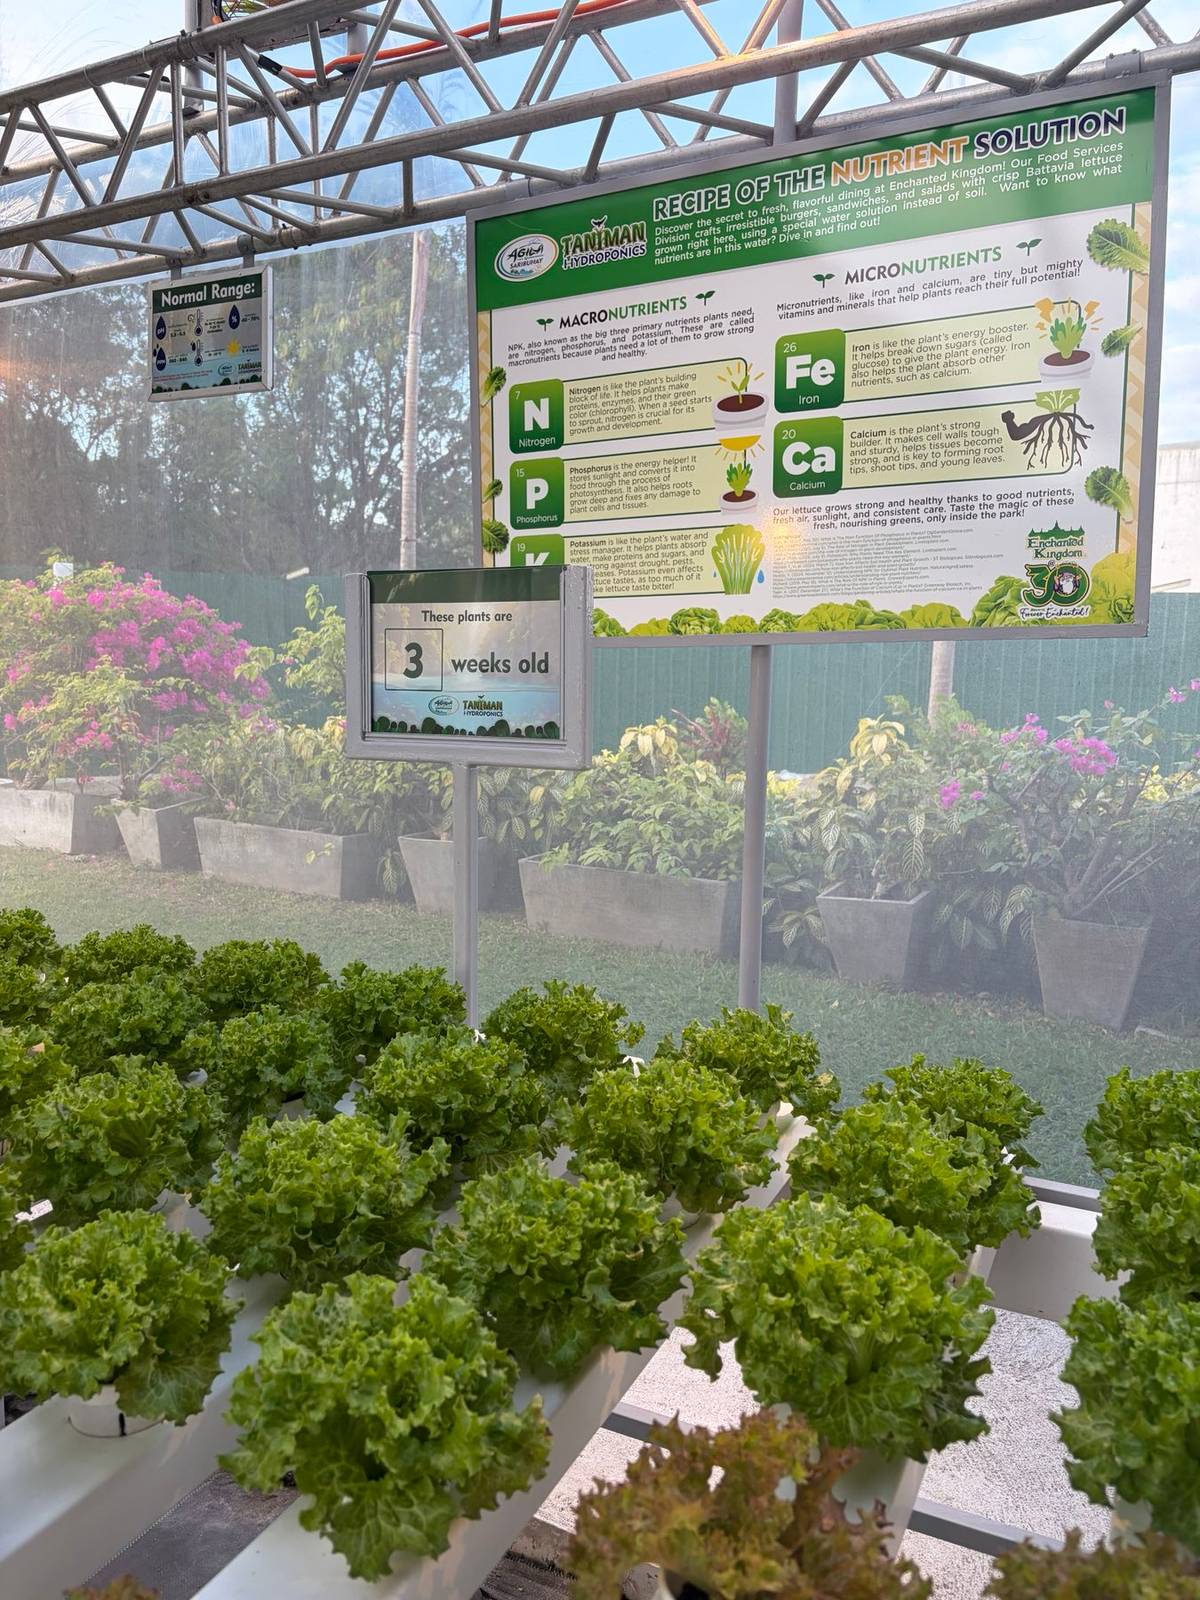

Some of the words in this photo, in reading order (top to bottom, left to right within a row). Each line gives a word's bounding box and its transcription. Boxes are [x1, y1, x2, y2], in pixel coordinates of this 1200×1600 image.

[653, 185, 729, 221] RECIPE
[736, 176, 770, 204] OF
[775, 164, 825, 196] THE
[832, 136, 969, 186] NUTRIENT
[974, 107, 1126, 159] SOLUTION
[655, 222, 692, 236] Discover
[697, 218, 711, 228] the
[715, 212, 743, 224] secret
[748, 210, 757, 219] to
[762, 203, 788, 216] fresh,
[792, 194, 833, 211] flavorful
[838, 190, 870, 202] dining
[874, 186, 884, 196] at
[889, 173, 949, 193] Enchanted
[951, 163, 1005, 182] Kingdom!
[1010, 160, 1030, 171] Our
[1037, 151, 1067, 166] Food
[1073, 144, 1122, 160] Services
[655, 233, 689, 245] Division
[695, 226, 720, 238] crafts
[726, 216, 774, 232] irresistible
[780, 209, 820, 223] burgers,
[826, 197, 888, 214] sandwiches,
[895, 190, 914, 202] and
[921, 184, 954, 198] salads
[961, 177, 985, 190] with
[991, 173, 1019, 185] crisp
[1026, 162, 1074, 179] Battavia
[1081, 154, 1122, 169] lettuce
[654, 244, 682, 257] grown
[687, 237, 708, 250] right
[713, 234, 736, 244] here,
[741, 229, 766, 240] using
[782, 218, 816, 234] special
[822, 214, 849, 225] water
[856, 206, 897, 219] solution
[903, 195, 942, 211] instead
[947, 192, 959, 203] of
[964, 188, 987, 200] soil.
[1000, 180, 1029, 194] Want
[1036, 178, 1048, 188] to
[1054, 172, 1085, 185] know
[1092, 164, 1121, 178] what
[654, 251, 693, 264] nutrients
[696, 248, 710, 257] are
[713, 246, 721, 254] in
[724, 242, 741, 252] this
[744, 235, 775, 249] water?
[779, 233, 800, 243] Dive
[803, 230, 812, 239] in
[814, 225, 833, 237] and
[837, 221, 856, 233] find
[859, 217, 880, 229] out!
[563, 244, 646, 270] HYDROPONICS
[844, 246, 1001, 285] MICRONUTRIENTS
[161, 286, 207, 307] Normal
[212, 282, 255, 299] Range:
[776, 296, 841, 311] Micronutrients,
[849, 292, 864, 301] like
[871, 289, 889, 298] iron
[897, 283, 914, 294] and
[922, 279, 961, 290] calcium,
[969, 275, 985, 284] are
[993, 271, 1012, 281] tiny
[1020, 266, 1037, 276] but
[1046, 260, 1082, 273] mighty
[778, 308, 814, 319] vitamins
[817, 303, 833, 313] and
[836, 298, 874, 310] minerals
[877, 294, 895, 305] that
[898, 292, 919, 302] help
[922, 287, 951, 300] plants
[954, 281, 981, 294] reach
[985, 279, 1008, 289] their
[1011, 275, 1027, 286] full
[1030, 267, 1079, 285] potential!
[560, 297, 687, 329] MACRONUTRIENTS
[784, 343, 796, 353] 26
[852, 343, 870, 352] Iron
[872, 341, 879, 350] is
[882, 339, 897, 348] like
[900, 337, 915, 346] the
[918, 332, 948, 346] plant's
[951, 329, 985, 340] energy
[988, 324, 1028, 336] booster.
[785, 354, 835, 389] Fe
[515, 391, 520, 399] 7
[569, 386, 600, 396] Nitrogen
[610, 382, 622, 391] like
[624, 381, 636, 389] the
[638, 378, 663, 389] plant's
[665, 375, 696, 384] building
[799, 395, 819, 404] Iron
[524, 398, 549, 431] N
[519, 436, 555, 448] Nitrogen
[782, 430, 795, 439] 20
[850, 429, 886, 439] Calcium
[889, 427, 895, 436] is
[898, 426, 913, 435] the
[916, 423, 946, 436] plant's
[949, 422, 980, 431] strong
[569, 464, 611, 474] Phosphorus
[620, 461, 632, 469] the
[634, 460, 660, 468] energy
[662, 456, 689, 466] helper!
[782, 442, 836, 475] Ca
[516, 469, 524, 477] 15
[790, 480, 825, 491] Calcium
[526, 479, 548, 509] P
[772, 508, 788, 516] Our
[792, 506, 821, 515] lettuce
[825, 505, 851, 515] grows
[855, 502, 884, 512] strong
[887, 499, 904, 509] and
[908, 497, 942, 508] healthy
[946, 495, 978, 505] thanks
[982, 494, 992, 503] to
[996, 492, 1022, 504] good
[1026, 489, 1074, 500] nutrients,
[516, 514, 557, 524] Phosphorus
[517, 544, 525, 552] 19
[569, 539, 606, 547] Potassium
[643, 534, 667, 544] plant's
[693, 531, 708, 539] and
[1028, 537, 1084, 548] Enchanted
[1034, 548, 1082, 560] Kingdom
[422, 610, 453, 621] These
[458, 610, 490, 624] plants
[494, 612, 512, 621] are
[403, 642, 423, 678] 3
[451, 652, 510, 673] weeks
[519, 652, 549, 673] old
